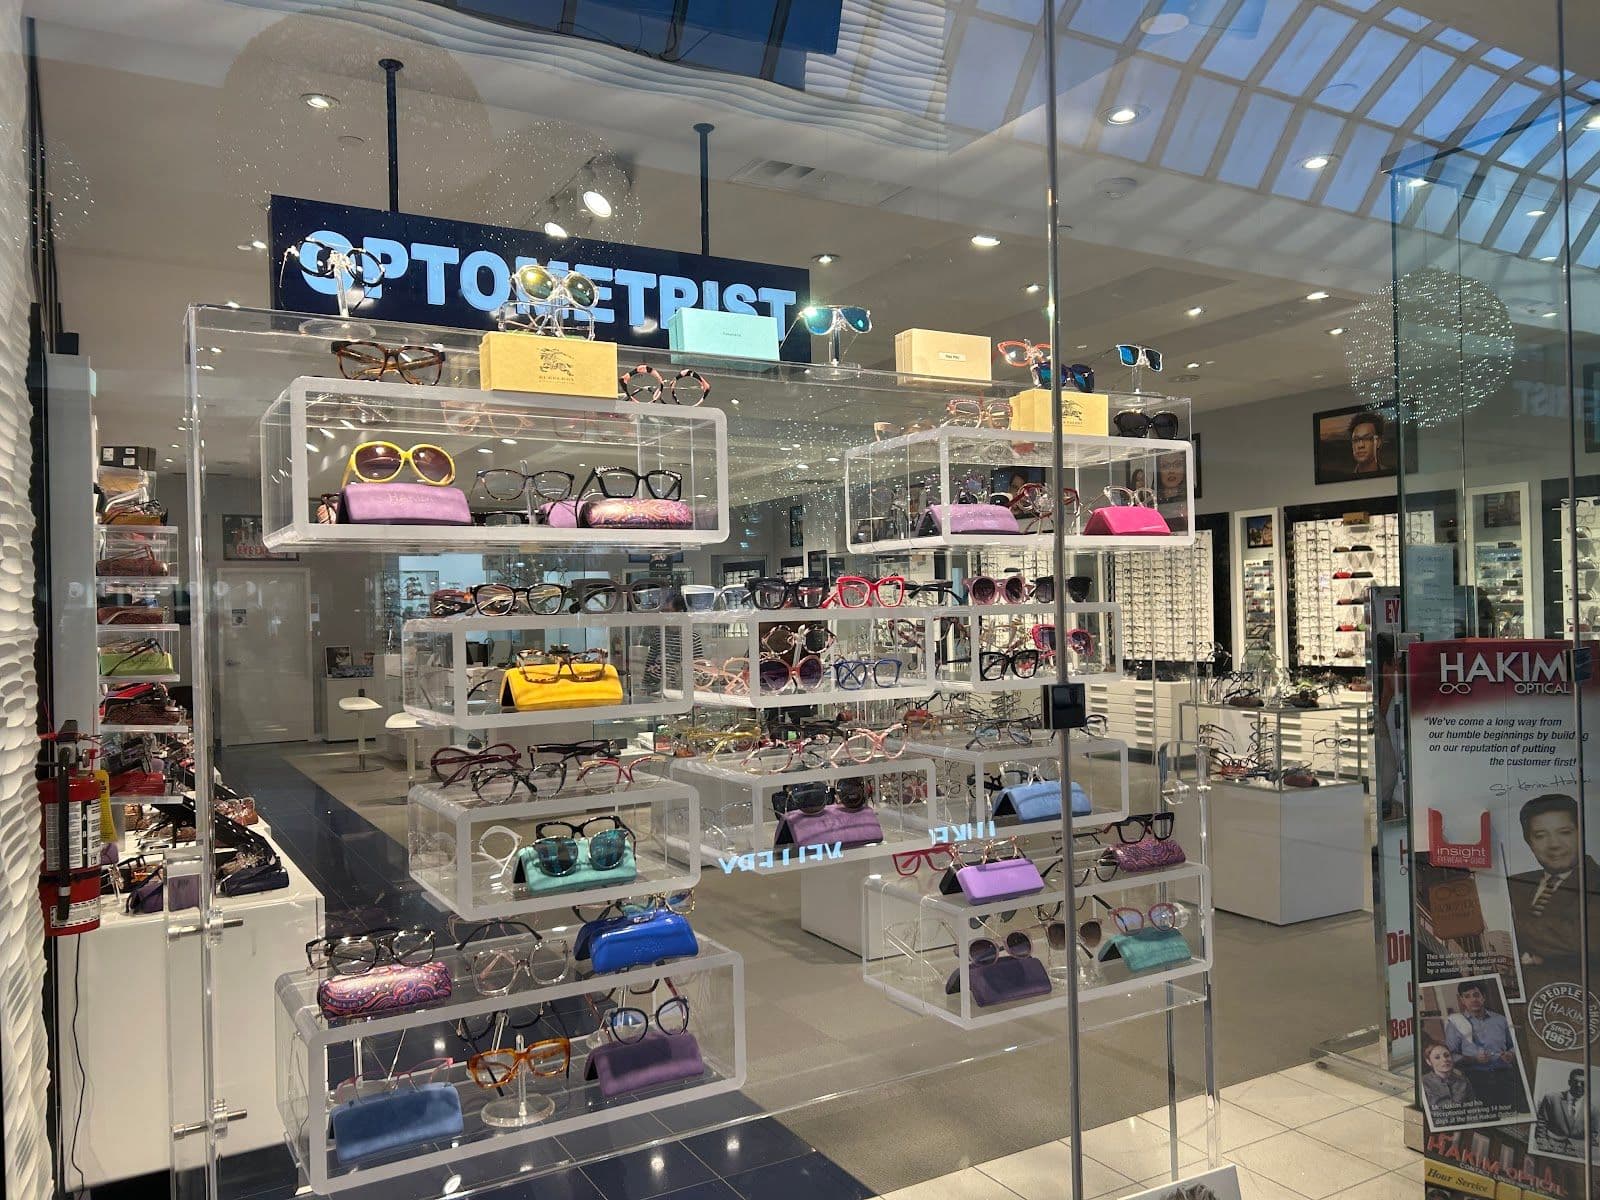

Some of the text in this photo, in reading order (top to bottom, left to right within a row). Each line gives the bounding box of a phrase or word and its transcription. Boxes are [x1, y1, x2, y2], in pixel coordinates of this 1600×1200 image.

[299, 229, 797, 341] OPTOMETRIST
[1440, 652, 1568, 683] HAKIM
[1514, 682, 1571, 694] OPTICAL
[1458, 718, 1484, 726] come
[1486, 718, 1493, 726] a
[1495, 717, 1515, 728] long
[1517, 718, 1537, 728] way
[1539, 717, 1562, 726] from
[1446, 730, 1481, 739] humble
[1483, 731, 1534, 741] beginnings
[1536, 731, 1548, 741] by
[1551, 731, 1589, 742] buildg
[1429, 743, 1556, 754] on our reputation of putting
[1489, 757, 1505, 766] the
[1506, 758, 1552, 767] customer
[1437, 846, 1486, 858] insight
[1532, 1001, 1544, 1021] THE
[1550, 1024, 1573, 1037] SINCE
[1545, 1030, 1573, 1047] 1967
[1427, 1133, 1501, 1175] HAKIM
[1427, 1168, 1488, 1193] Hour Service
